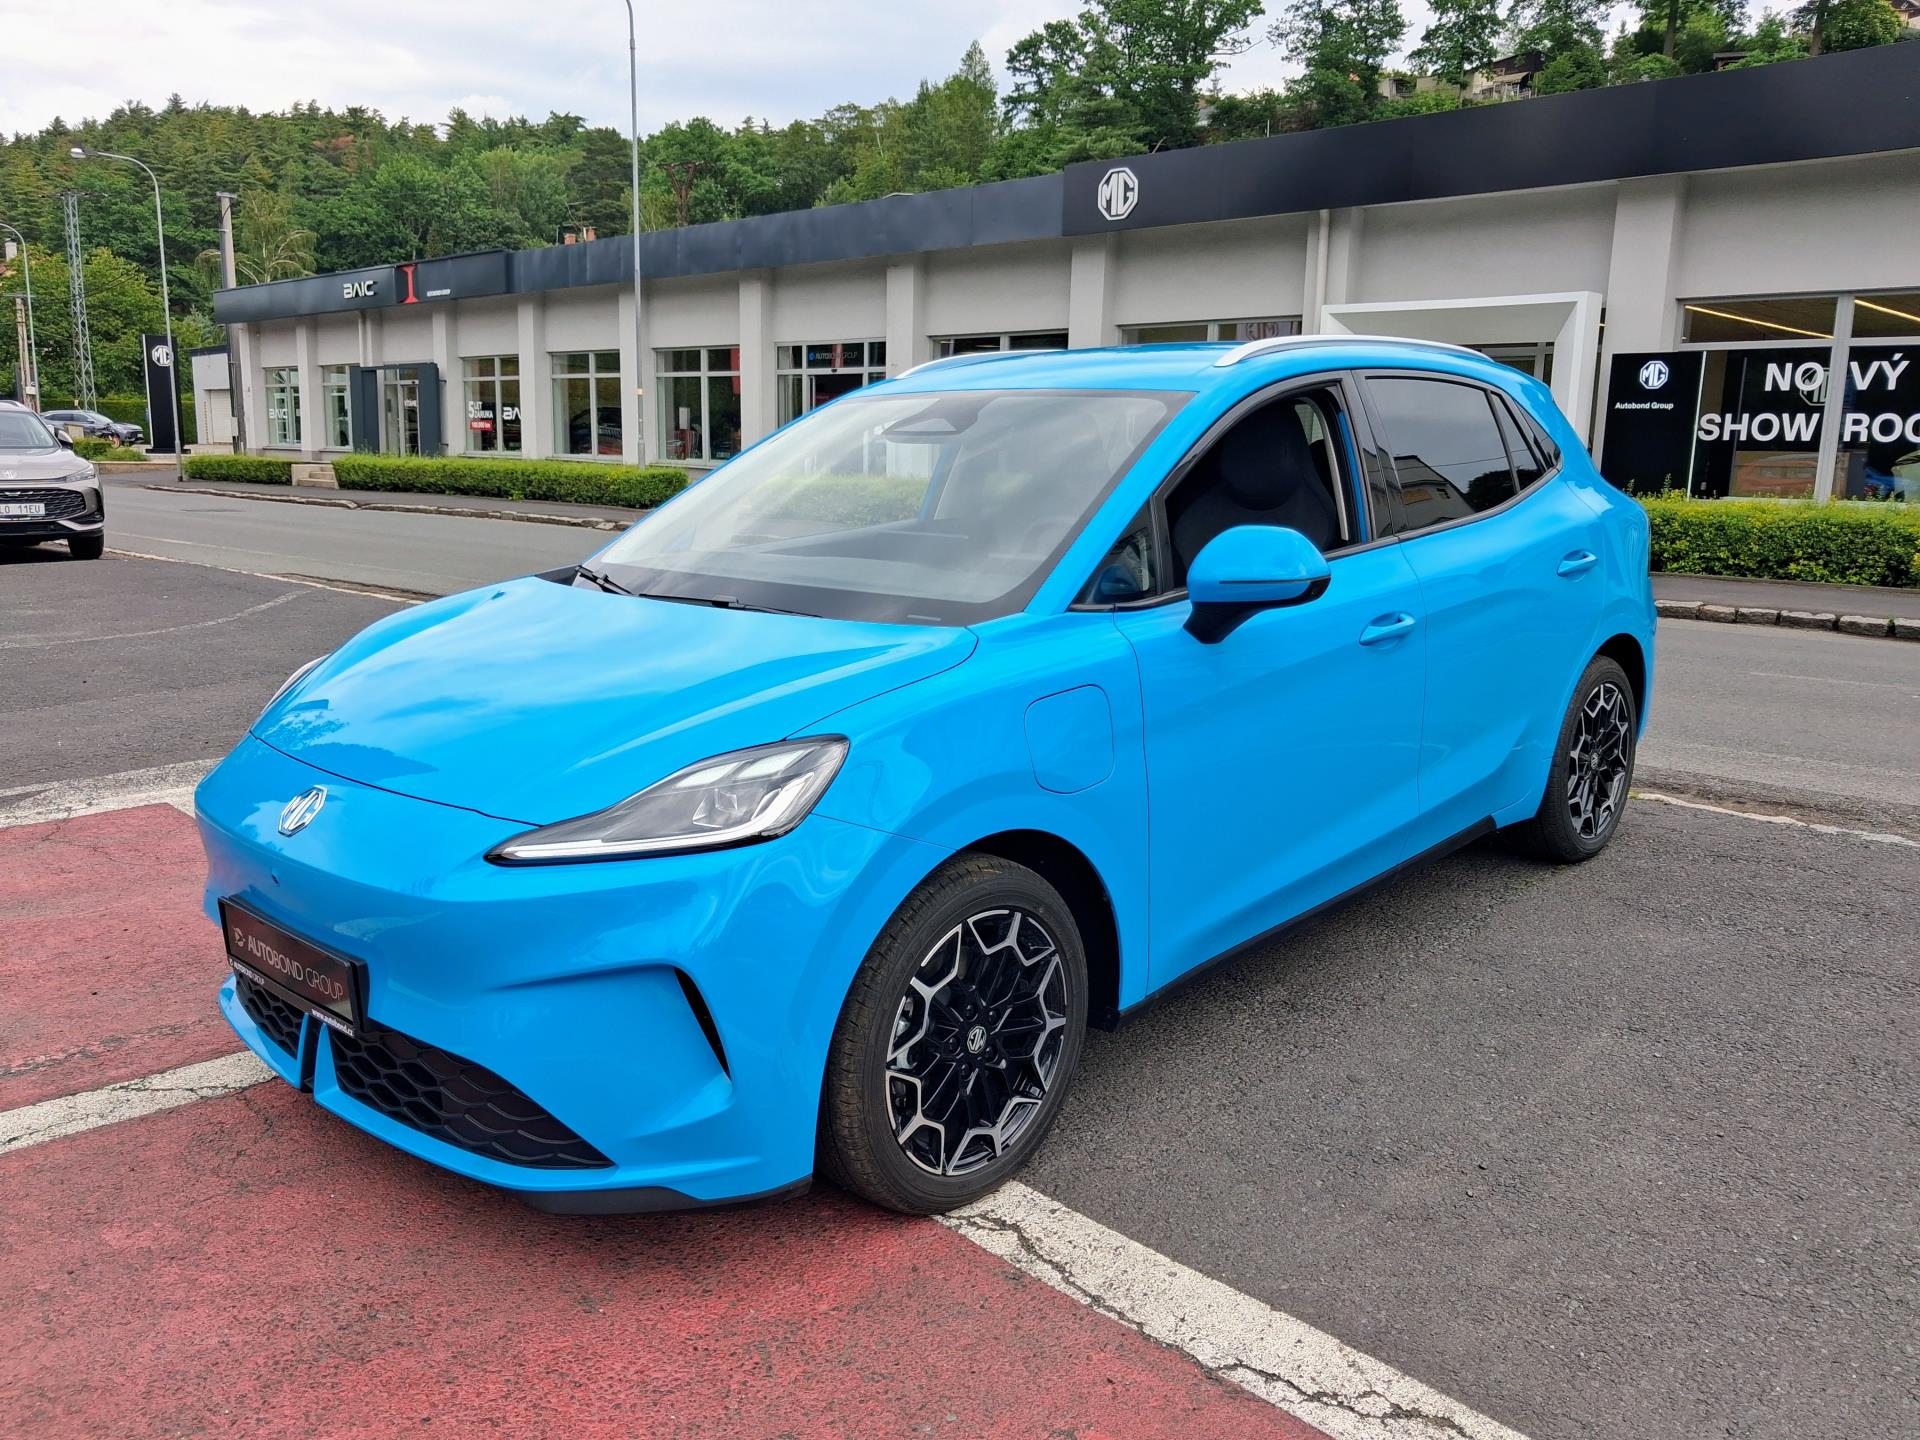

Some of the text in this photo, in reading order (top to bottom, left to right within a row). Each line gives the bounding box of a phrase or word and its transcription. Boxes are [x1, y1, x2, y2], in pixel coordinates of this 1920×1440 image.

[1100, 170, 1136, 217] MG
[343, 280, 375, 299] BAIC
[1642, 362, 1667, 388] MG
[468, 401, 475, 419] 5
[1615, 402, 1674, 411] Autobond Group
[281, 788, 324, 833] MG
[248, 935, 344, 1000] AUTOBOND GROUP
